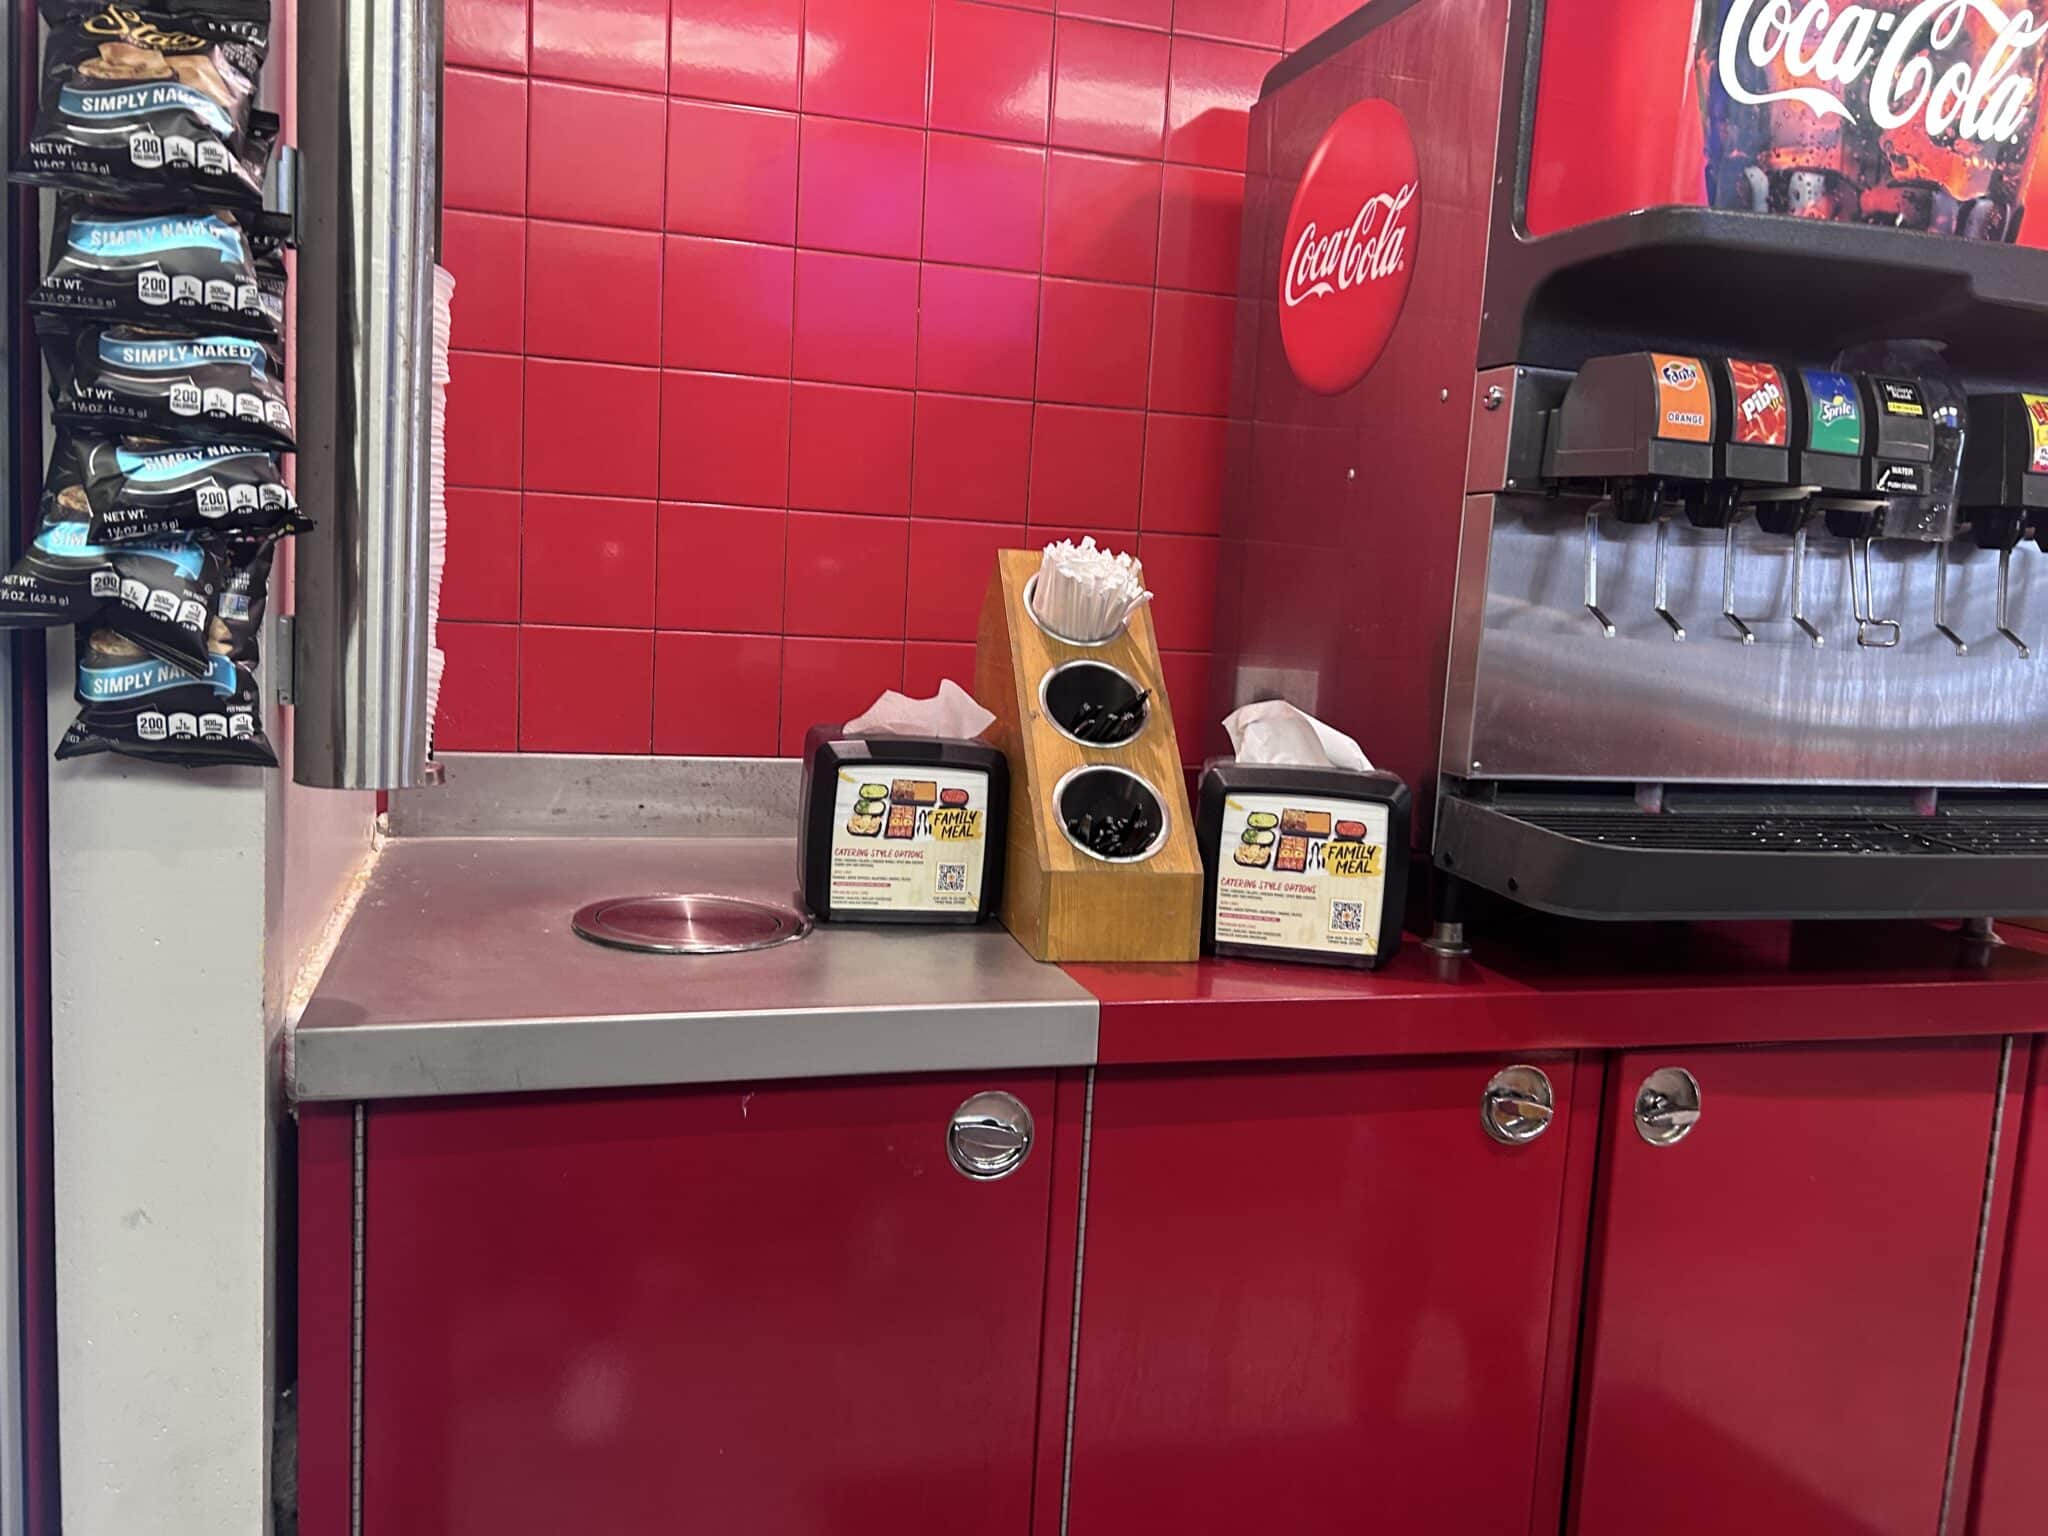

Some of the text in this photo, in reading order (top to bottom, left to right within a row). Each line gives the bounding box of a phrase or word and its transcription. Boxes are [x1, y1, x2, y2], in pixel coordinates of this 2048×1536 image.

[1718, 0, 2048, 144] Coca-Cola
[82, 91, 149, 113] SIMPLY
[31, 142, 76, 155] NET WT.
[133, 138, 160, 154] 200
[91, 226, 156, 246] SIMPLY
[1285, 180, 1418, 306] Coca-Cola
[43, 277, 84, 291] ET WT.
[141, 276, 166, 292] 200
[123, 344, 252, 364] SIMPLY NAKED
[1662, 366, 1697, 385] Fanta
[96, 388, 116, 401] WT.
[173, 388, 198, 404] 200
[1740, 381, 1781, 423] Pibb
[1667, 410, 1704, 425] ORANGE
[1822, 401, 1853, 419] Sprite
[143, 450, 203, 472] SIMPLY
[200, 492, 224, 506] 200
[103, 508, 149, 523] NET WT.
[19, 575, 38, 589] WT.
[93, 576, 118, 589] 200
[93, 670, 152, 694] SIMPLY
[139, 716, 164, 730] 200
[933, 810, 978, 826] FAMILY
[940, 825, 974, 839] MEAL
[834, 847, 925, 860] CATERING STYLE OPTIONS
[1327, 845, 1377, 860] FAMILY
[1335, 859, 1373, 875] MEAL
[1220, 877, 1257, 890] CATERING
[1258, 880, 1283, 892] STYLE
[1283, 882, 1317, 895] OPTIONS
